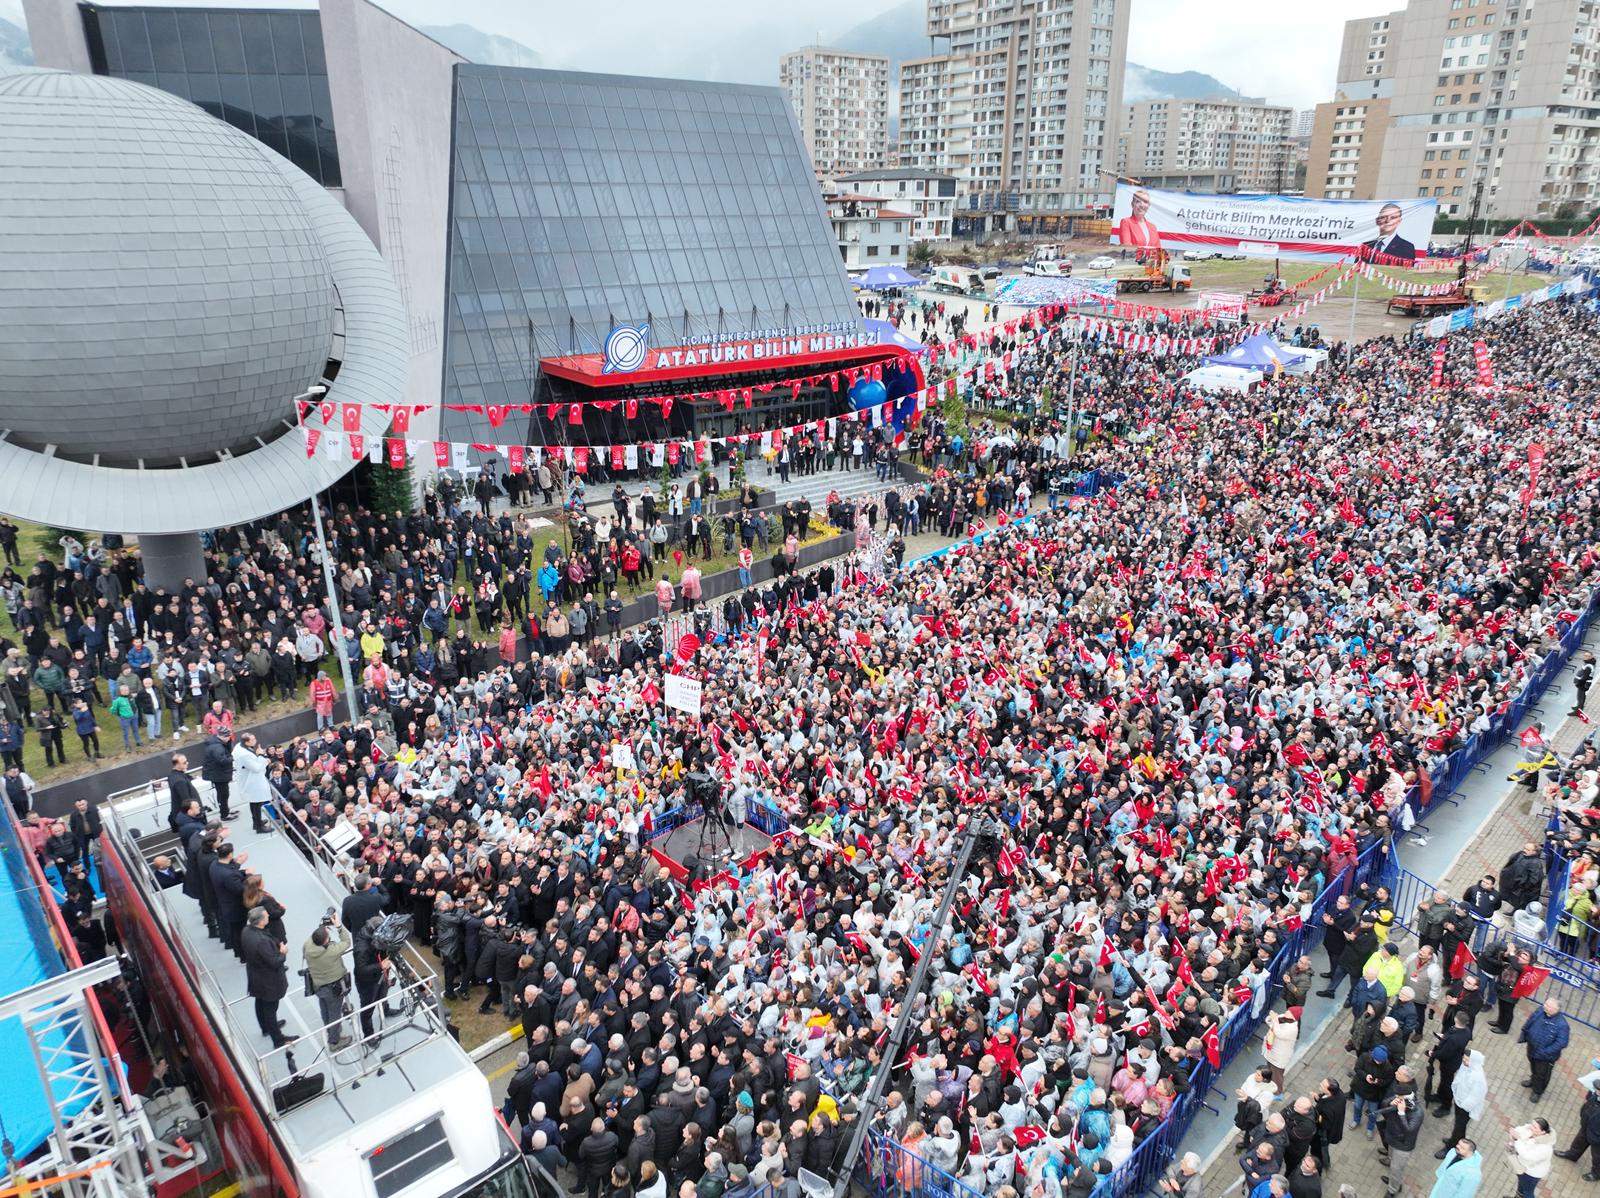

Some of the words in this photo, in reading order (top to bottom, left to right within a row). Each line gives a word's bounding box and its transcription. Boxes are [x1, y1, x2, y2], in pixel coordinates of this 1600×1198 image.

[1176, 208, 1229, 222] Atatürk
[1230, 211, 1266, 225] Bilim
[1185, 220, 1246, 235] şehrimize
[1248, 225, 1295, 240] hayırlı
[1297, 229, 1342, 240] olsun.
[796, 319, 858, 335] BELEDİYESİ
[656, 344, 748, 368] ATATÜRK
[753, 337, 803, 358] BİLİM
[809, 327, 881, 352] MERKEZİ
[679, 682, 700, 691] CHP
